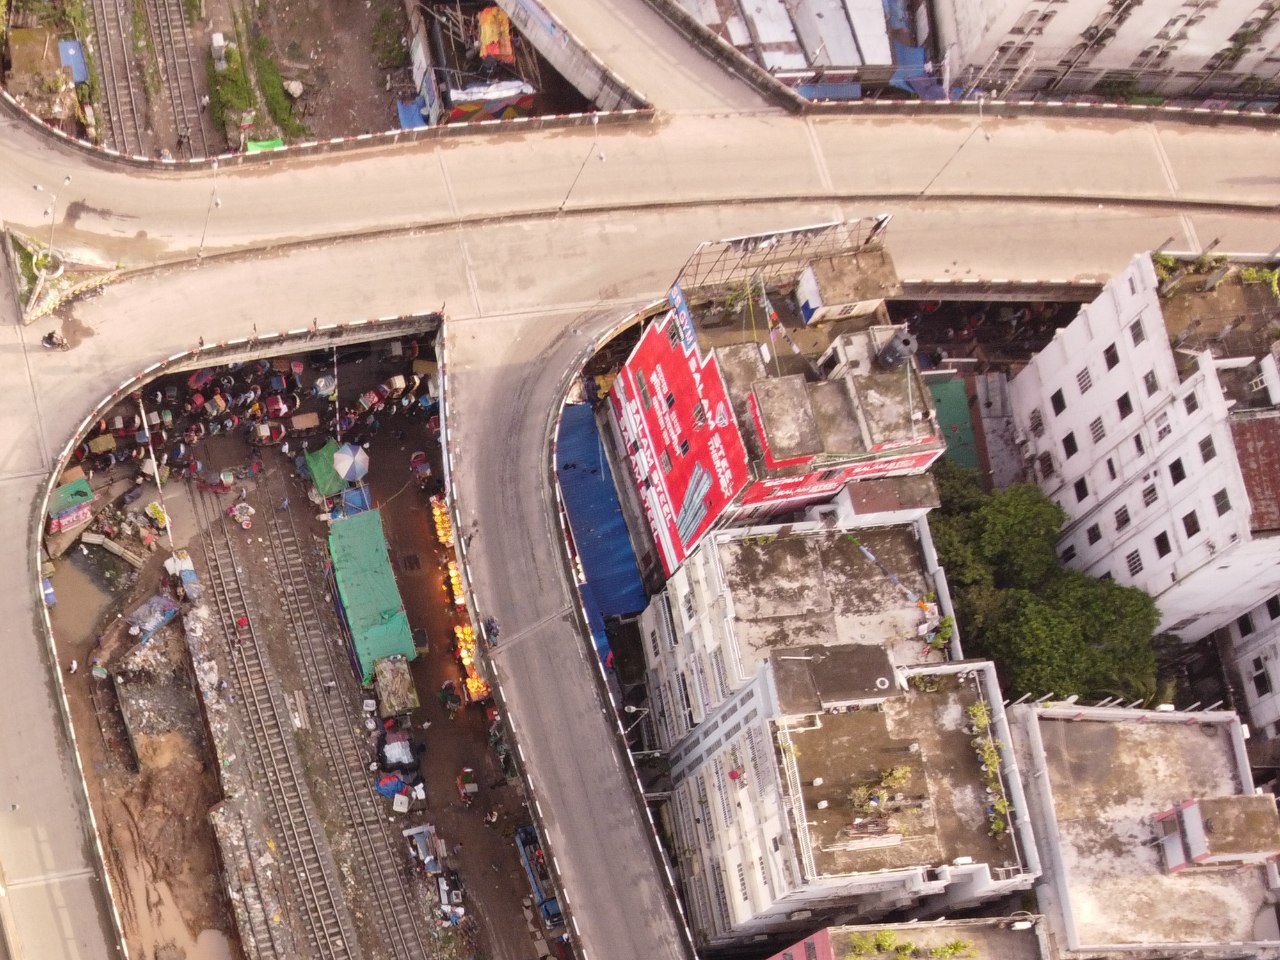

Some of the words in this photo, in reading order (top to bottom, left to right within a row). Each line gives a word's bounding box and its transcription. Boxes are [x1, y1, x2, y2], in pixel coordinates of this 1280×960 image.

[679, 311, 694, 345] GYM
[688, 357, 715, 431] SALAM
[620, 416, 642, 483] SALAM
[639, 486, 659, 543] STEEL
[630, 398, 654, 466] SALAM
[651, 469, 671, 527] STEEL
